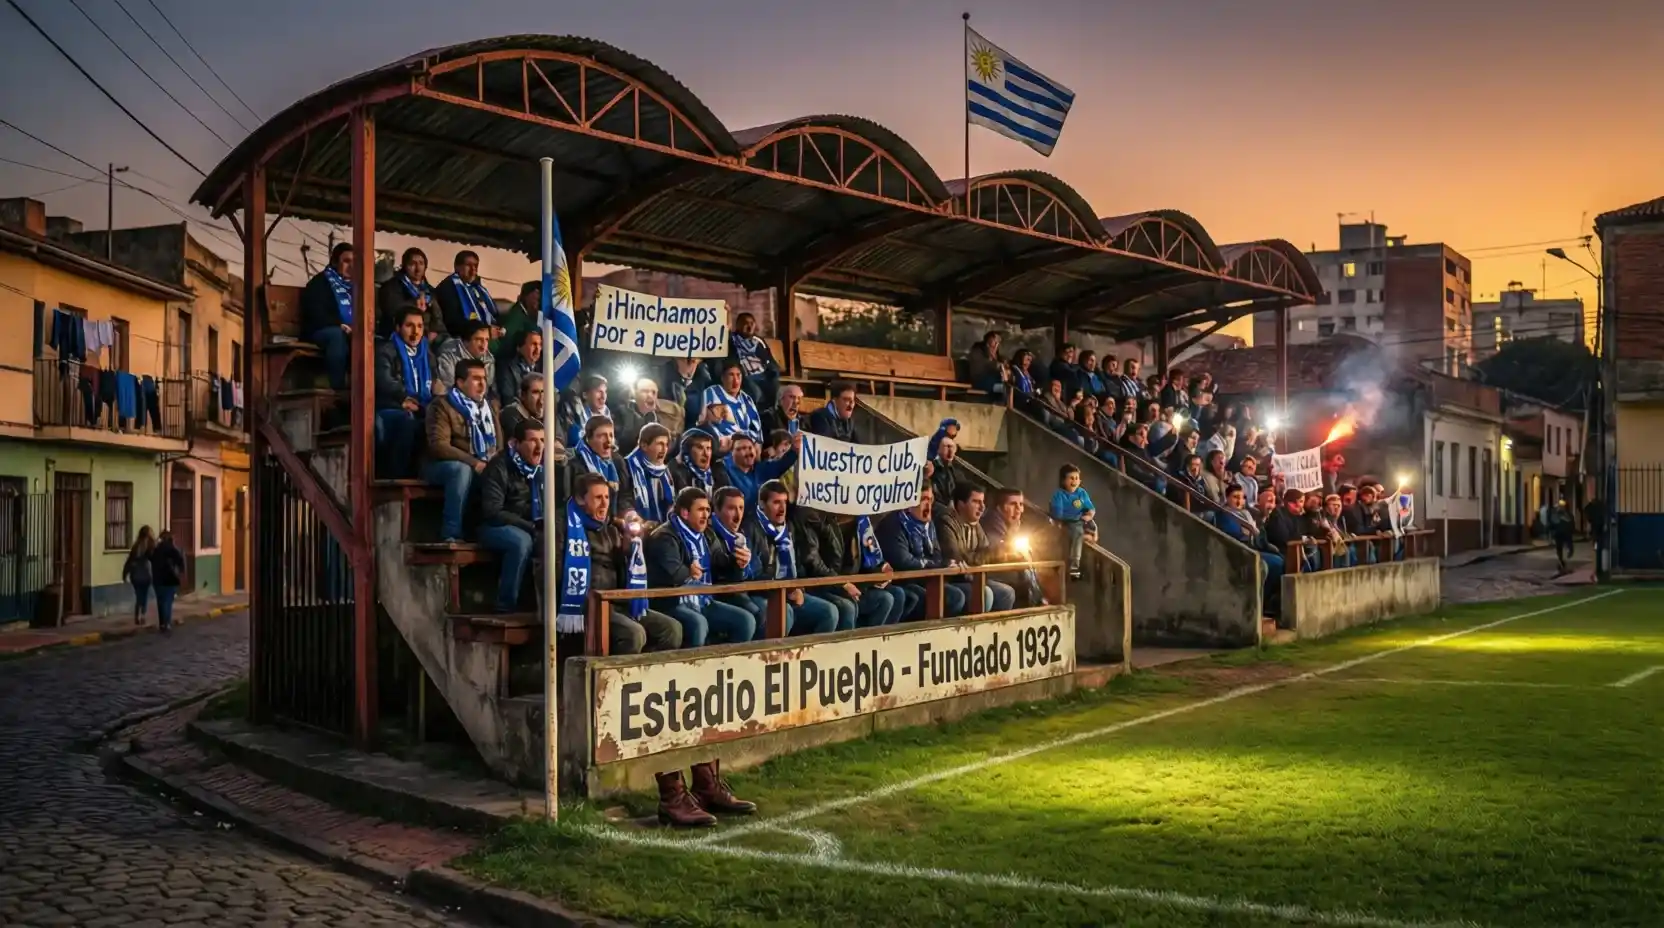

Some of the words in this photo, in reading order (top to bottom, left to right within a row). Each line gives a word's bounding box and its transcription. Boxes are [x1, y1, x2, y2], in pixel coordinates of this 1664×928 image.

[607, 290, 717, 324] ¡Hinchamos
[594, 322, 628, 348] por
[634, 329, 645, 347] a
[802, 434, 872, 474] Nuestro
[878, 442, 917, 472] club,
[620, 668, 755, 741] Estadio
[764, 662, 789, 716] El
[918, 632, 1011, 688] Fundado
[1016, 624, 1062, 669] 1932
